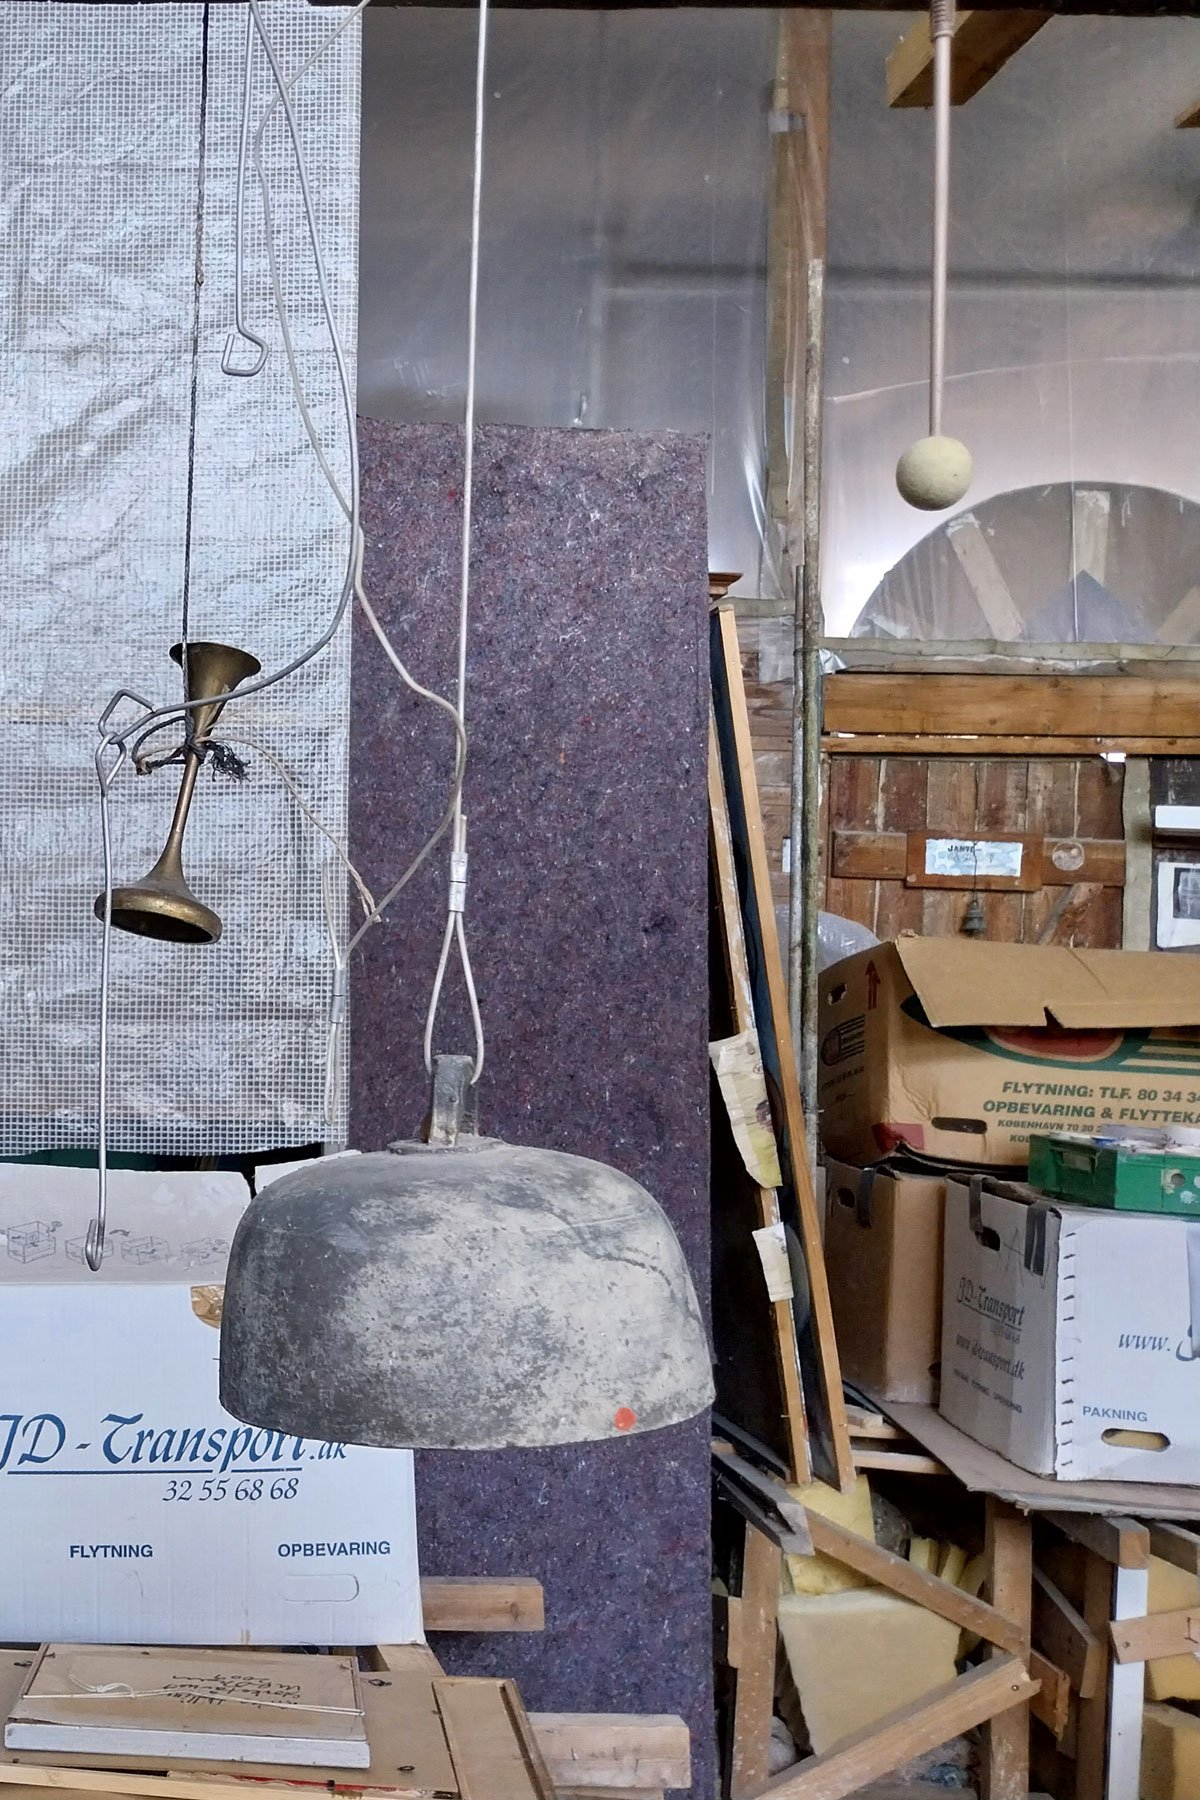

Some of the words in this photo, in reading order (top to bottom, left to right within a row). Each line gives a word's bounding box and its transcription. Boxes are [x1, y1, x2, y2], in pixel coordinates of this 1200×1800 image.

[1002, 1081, 1094, 1098] FLYTNING:
[1099, 1086, 1132, 1101] TLF.
[1137, 1088, 1158, 1101] 80
[1162, 1089, 1182, 1103] 34
[983, 1099, 1096, 1118] OPBEVARING
[1101, 1107, 1113, 1119] &
[997, 1119, 1065, 1131] KØBENHAVN
[1082, 1405, 1148, 1422] PAKNING
[162, 1480, 193, 1501] 32
[198, 1478, 231, 1501] 55
[234, 1478, 263, 1501] 68
[269, 1477, 300, 1500] 68
[69, 1544, 154, 1559] FLYTNING
[278, 1541, 392, 1558] OPBEVARING
